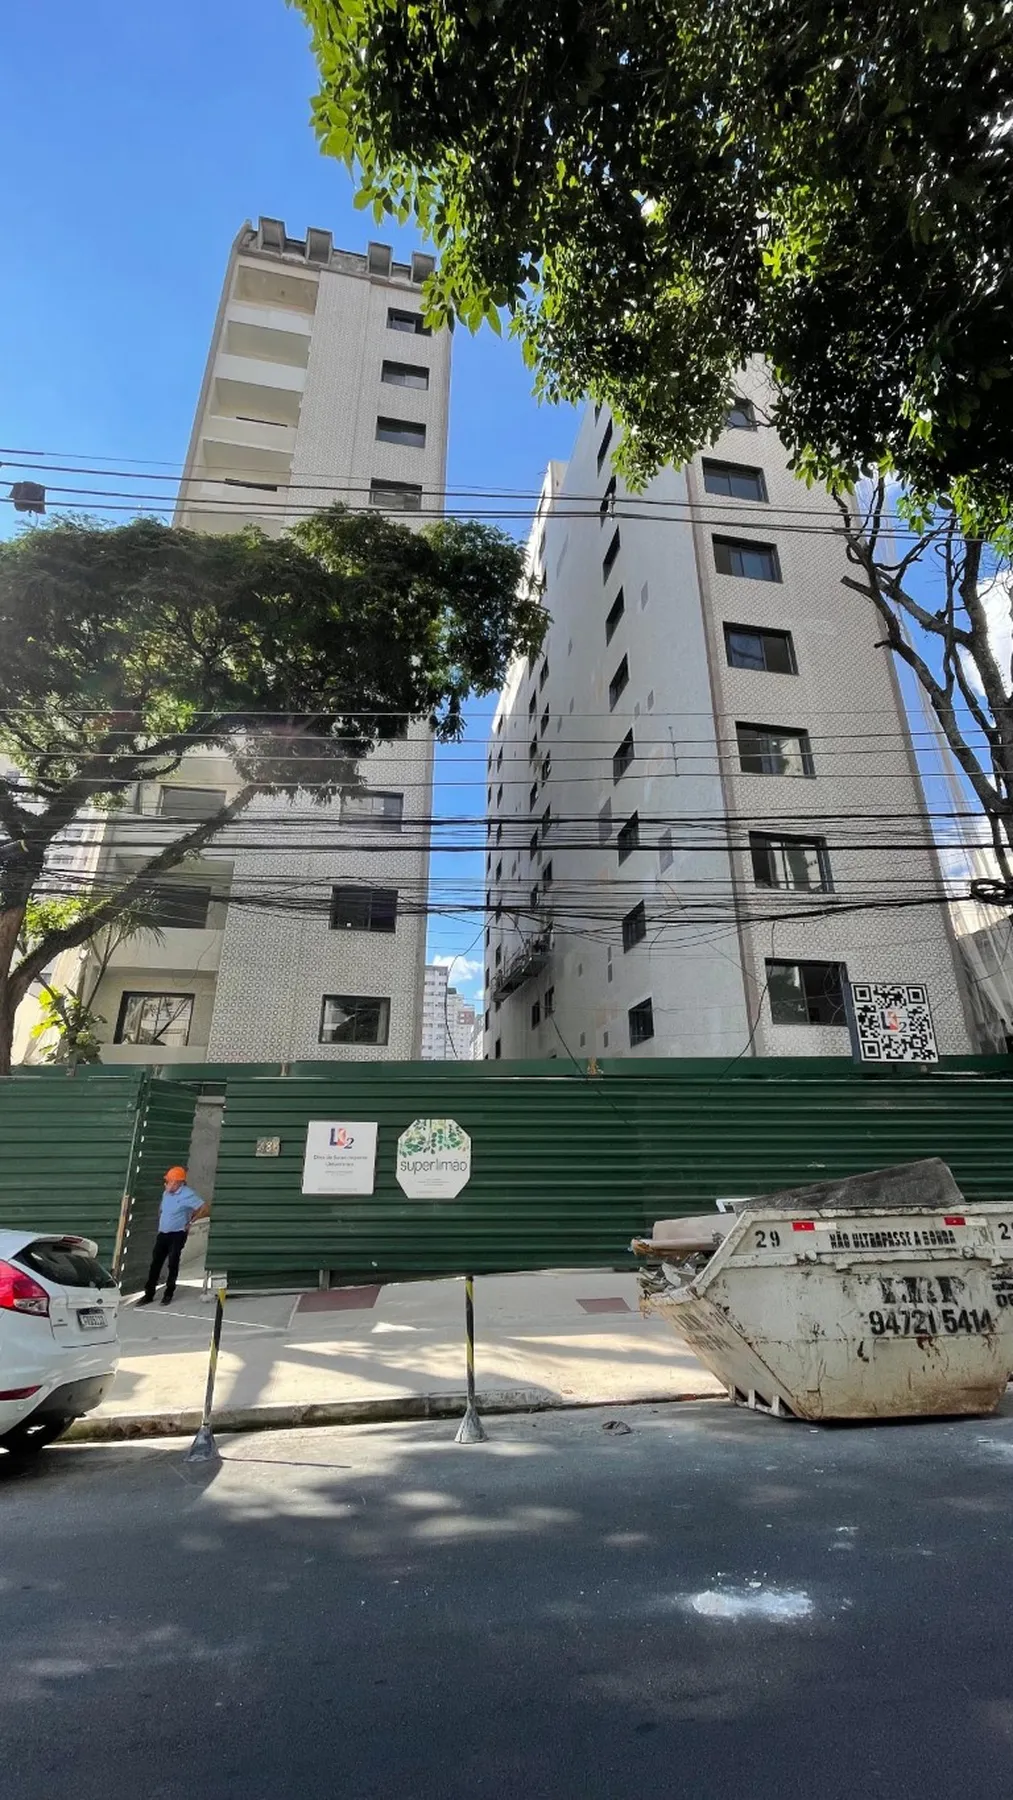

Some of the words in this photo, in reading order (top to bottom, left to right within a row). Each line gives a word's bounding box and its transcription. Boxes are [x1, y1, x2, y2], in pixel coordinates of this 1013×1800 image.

[755, 1230, 780, 1248] 29
[829, 1231, 851, 1249] NÃO
[852, 1231, 912, 1248] ULTRAPASSE
[914, 1231, 922, 1246] A
[998, 1222, 1013, 1240] 2
[868, 1309, 938, 1335] 94721
[941, 1308, 995, 1333] 5414
